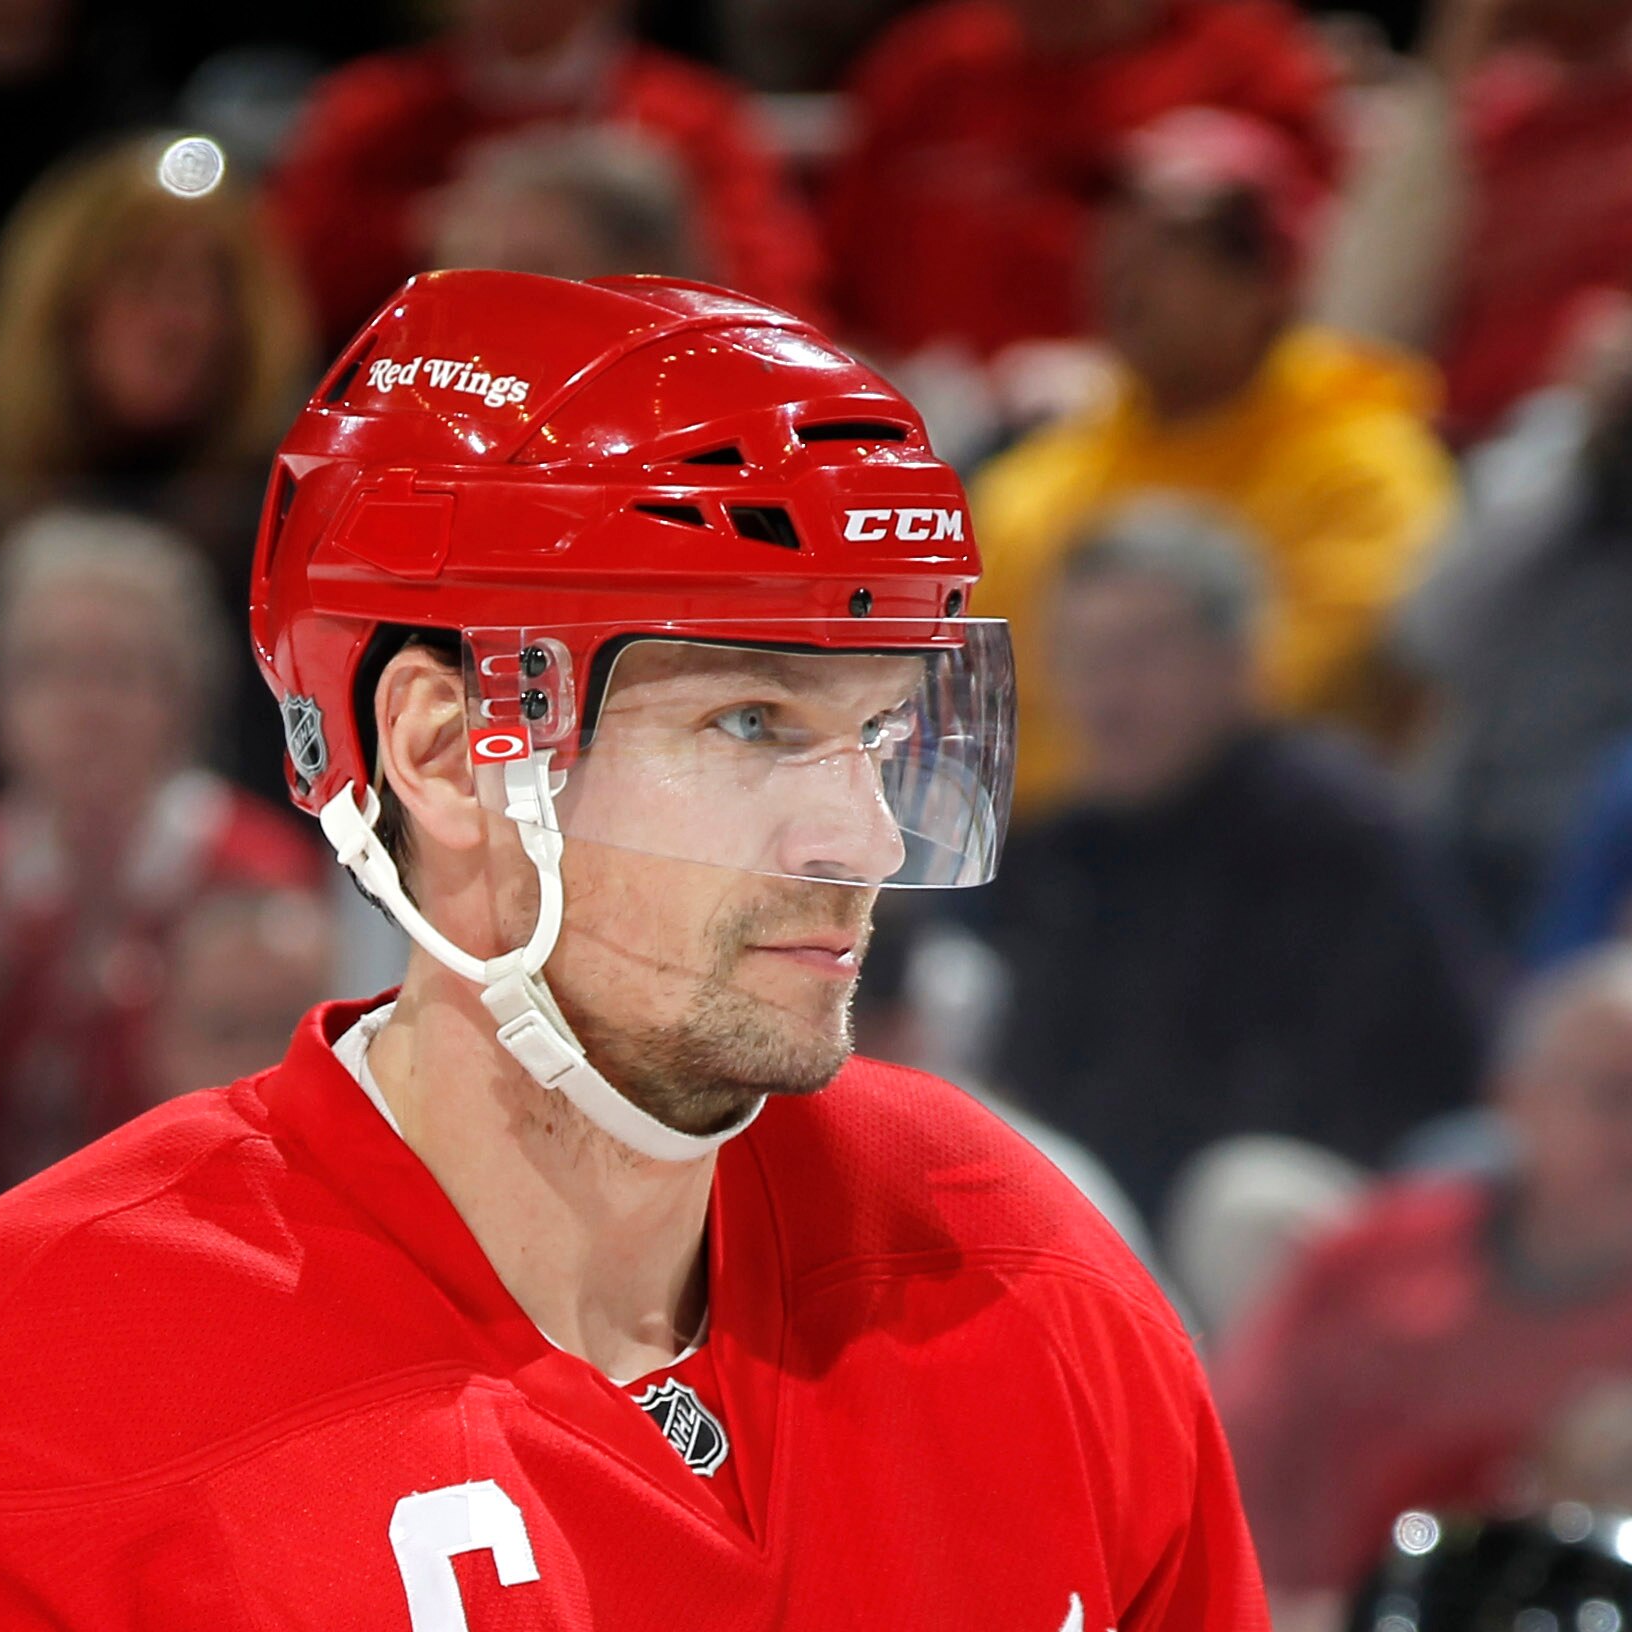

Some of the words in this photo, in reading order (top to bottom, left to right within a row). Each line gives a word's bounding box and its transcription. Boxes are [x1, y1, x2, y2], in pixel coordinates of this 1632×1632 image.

[366, 356, 423, 394] Red
[423, 359, 531, 408] Wings
[843, 508, 964, 542] CCM
[668, 1403, 697, 1457] NHL
